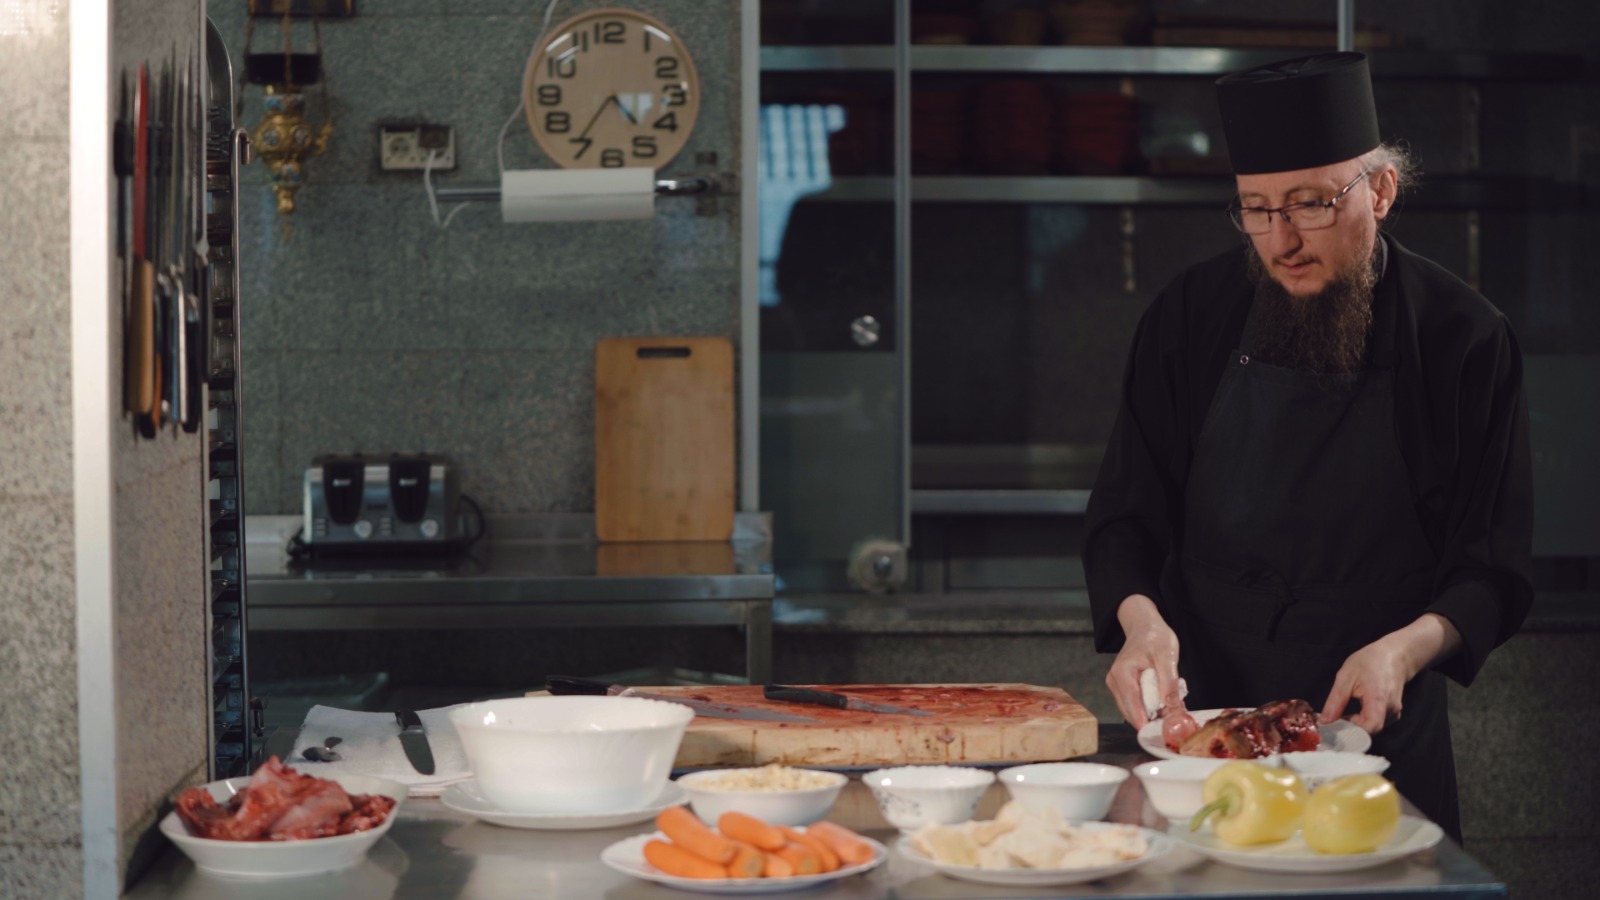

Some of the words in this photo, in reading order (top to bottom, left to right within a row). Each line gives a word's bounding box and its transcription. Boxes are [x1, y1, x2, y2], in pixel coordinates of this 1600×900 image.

[572, 30, 588, 52] 11
[594, 21, 626, 44] 12
[644, 28, 651, 52] 1
[548, 55, 576, 78] 10
[655, 56, 679, 79] 2
[538, 84, 562, 106] 9
[662, 84, 687, 106] 3
[545, 111, 570, 134] 8
[652, 112, 678, 133] 4
[568, 136, 593, 160] 7
[600, 148, 625, 169] 6
[632, 135, 658, 159] 5
